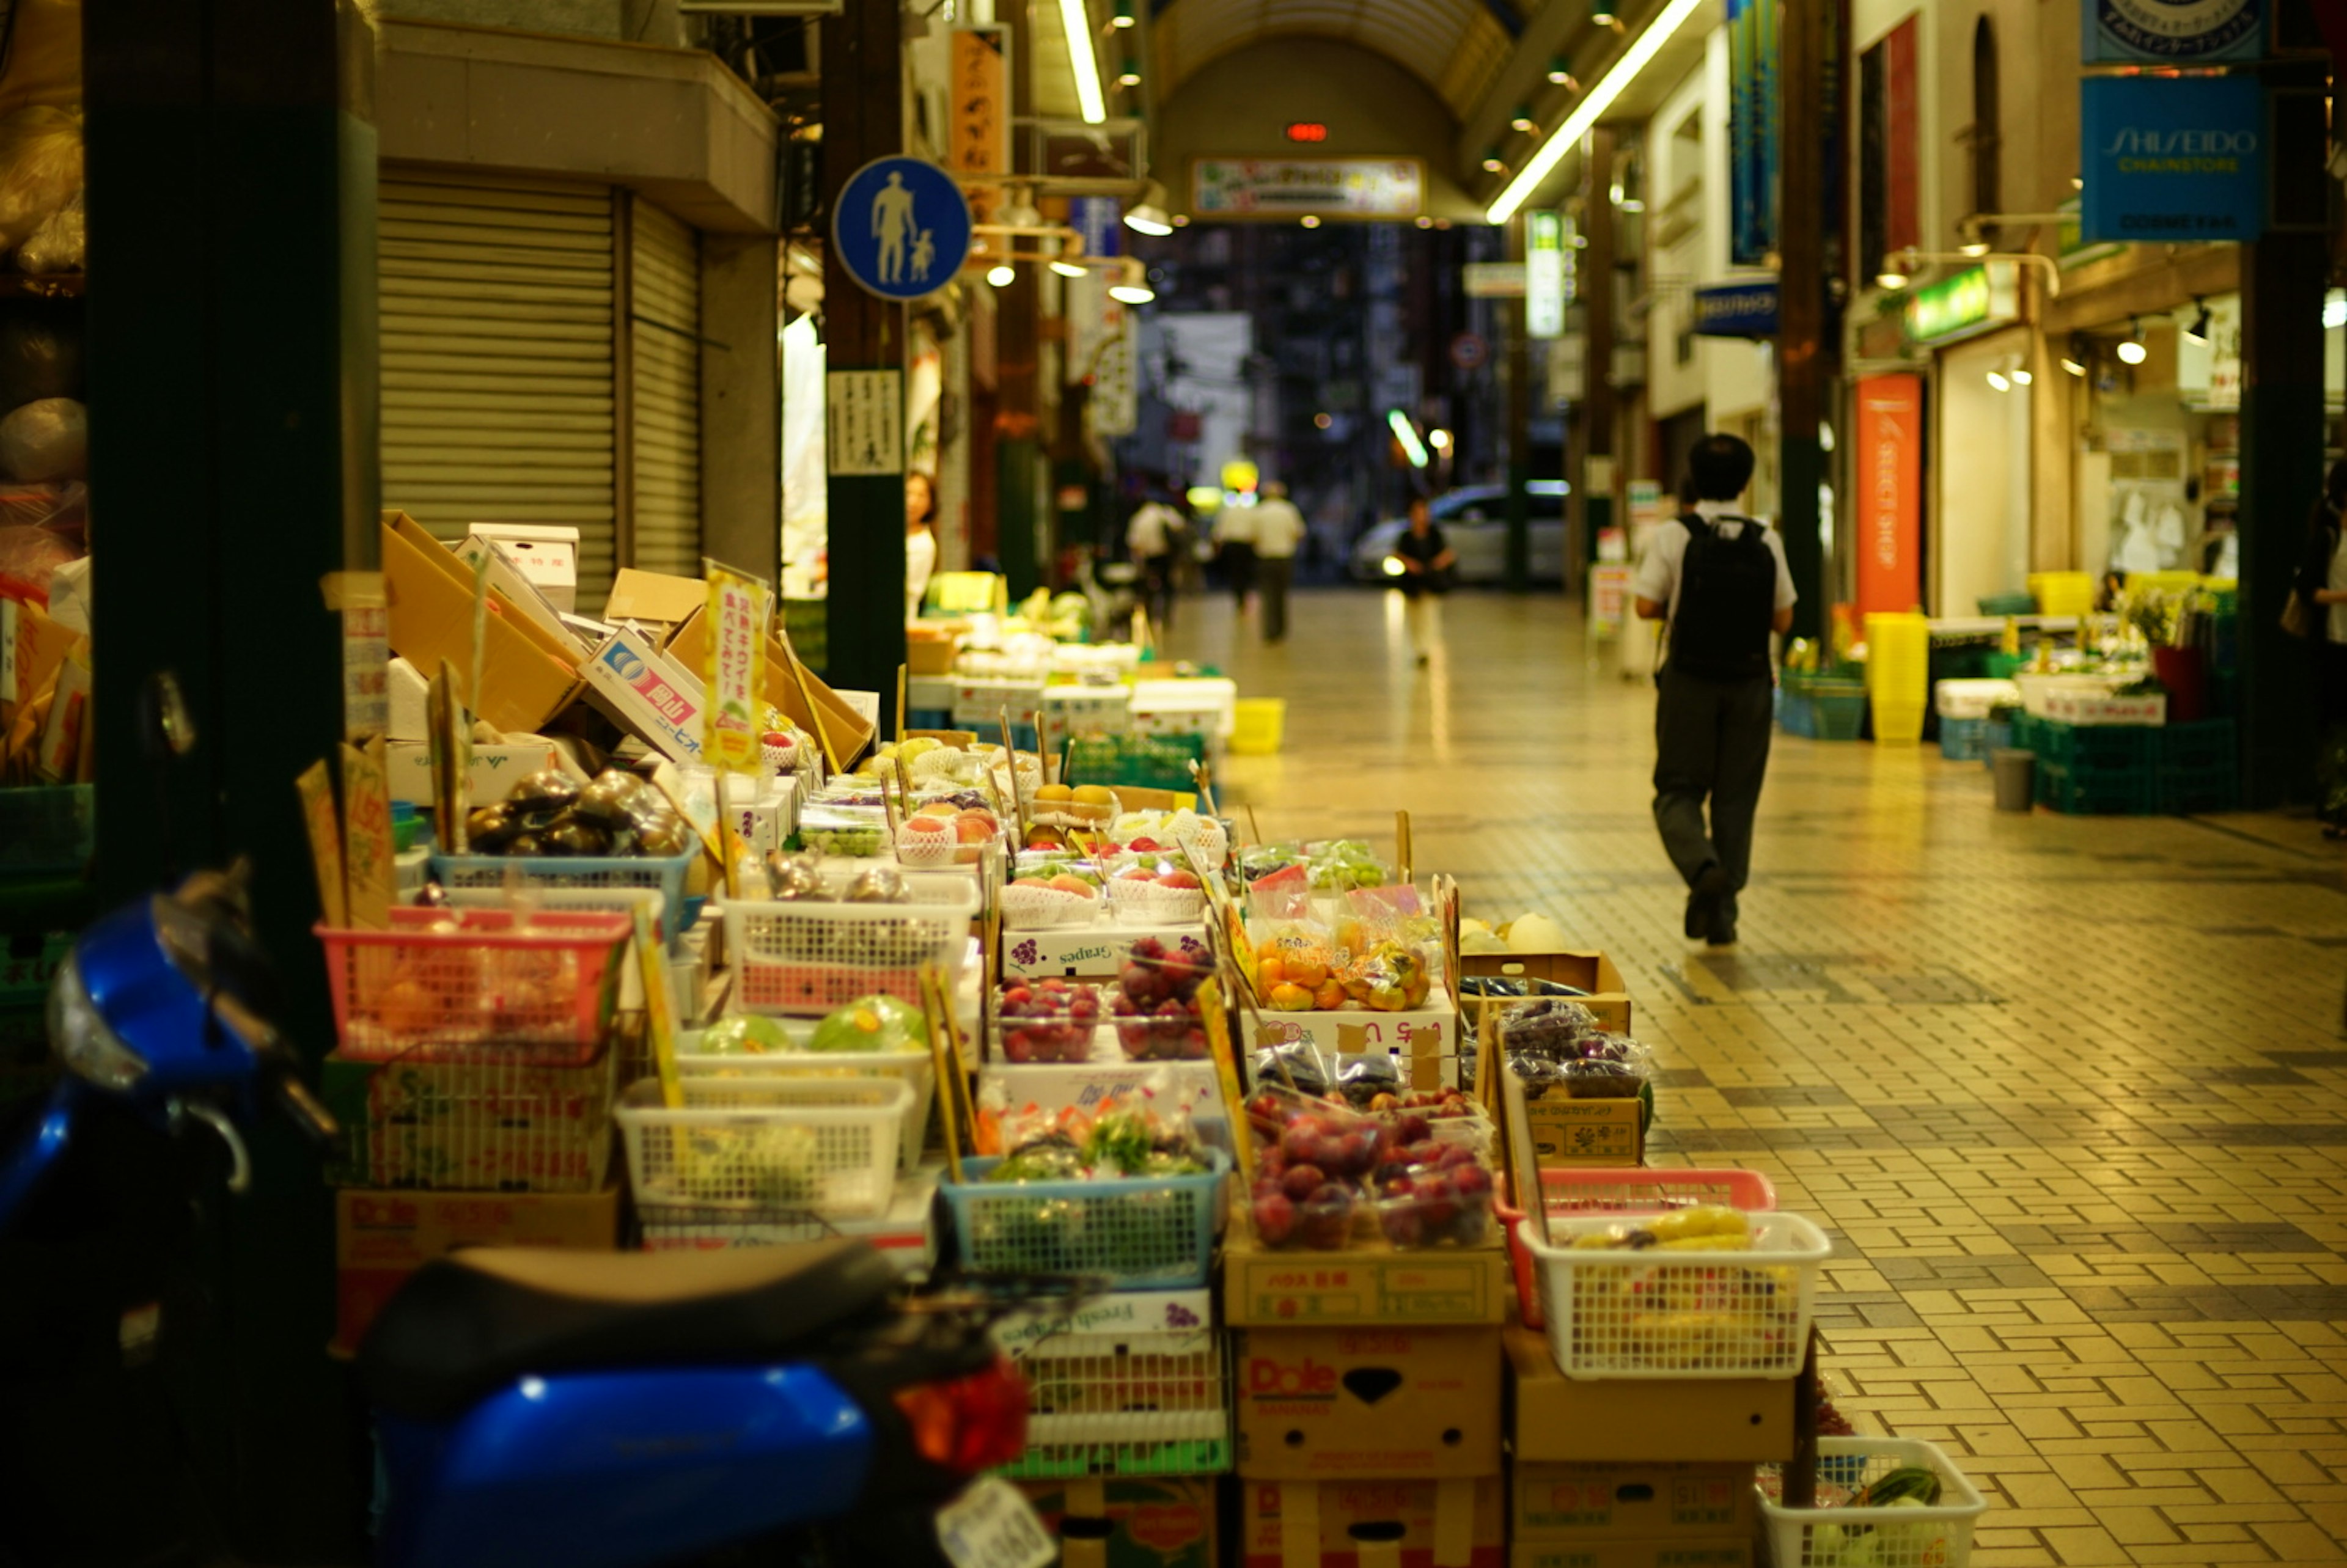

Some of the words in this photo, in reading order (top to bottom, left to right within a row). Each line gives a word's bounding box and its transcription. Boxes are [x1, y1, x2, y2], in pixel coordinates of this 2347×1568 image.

[2103, 126, 2258, 158] SHISEIDO
[2118, 157, 2239, 172] CHAINSTORE
[645, 683, 688, 722] 岡山
[1059, 945, 1112, 967] Grapes
[1250, 1357, 1337, 1394] Dole
